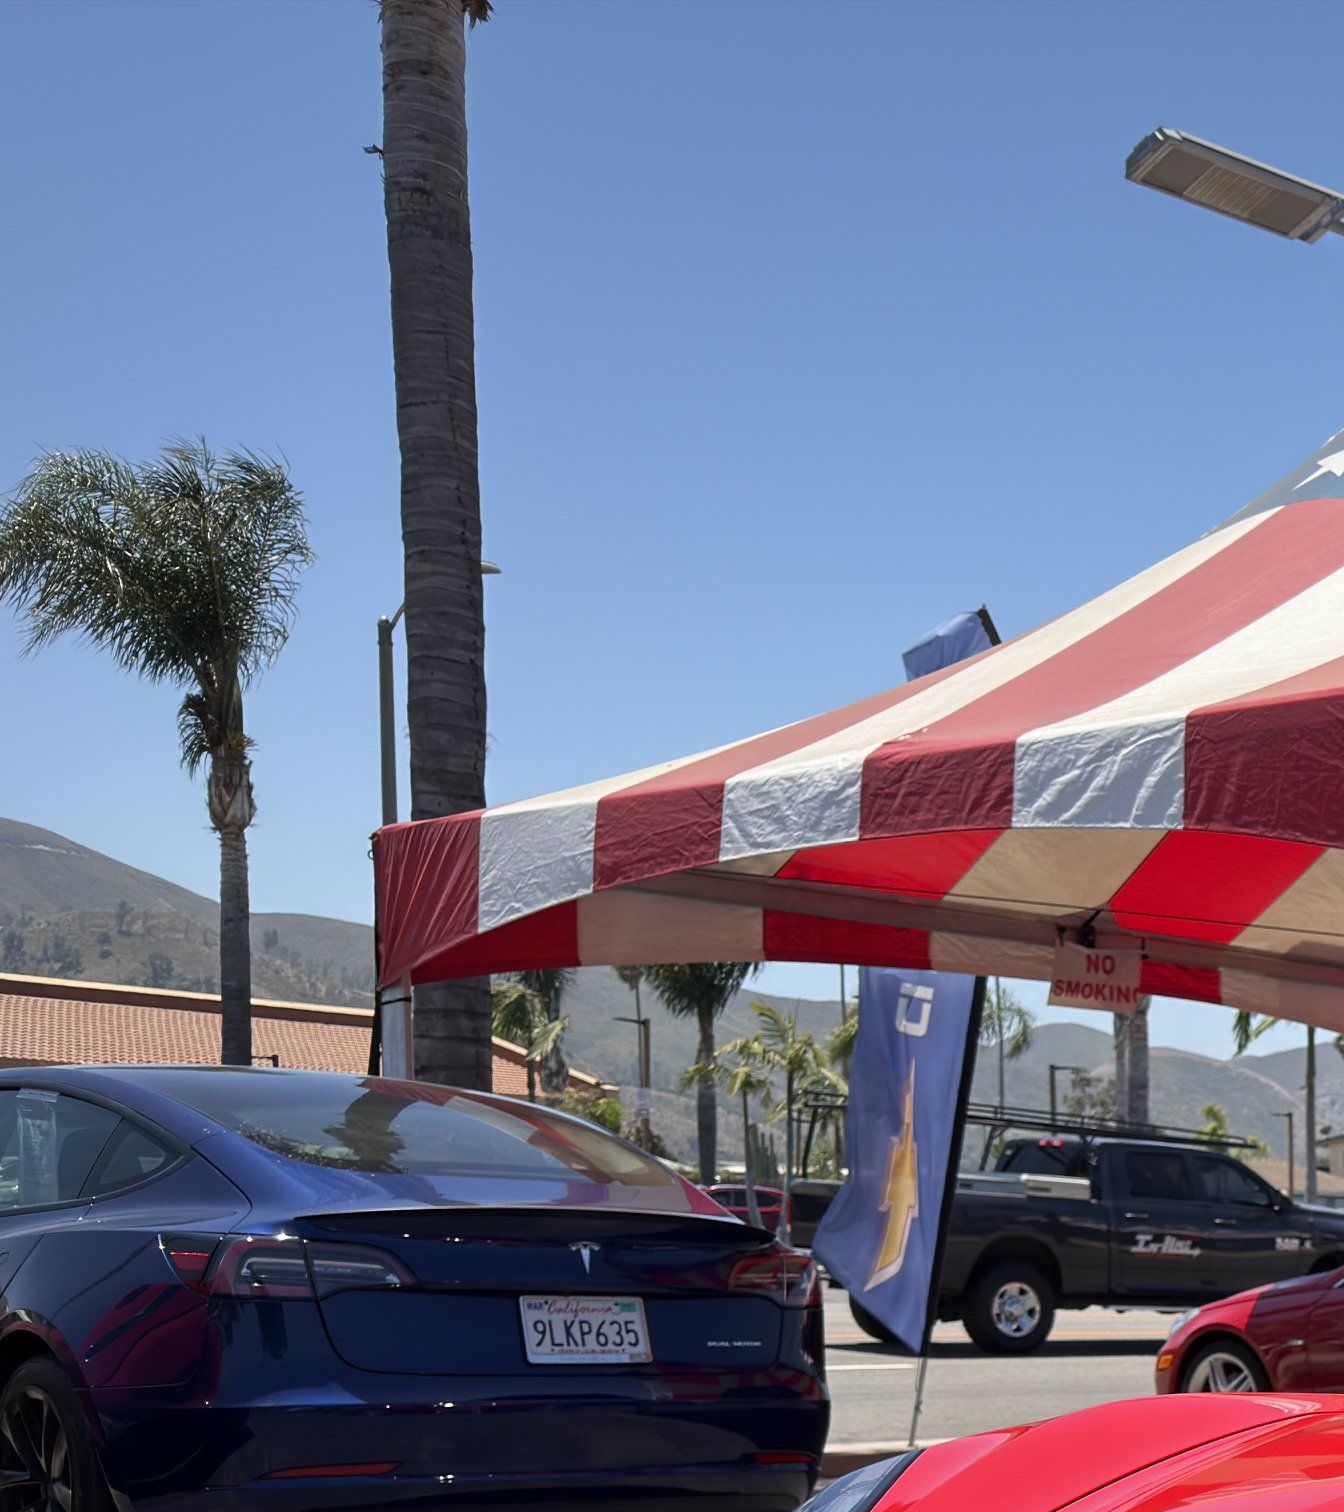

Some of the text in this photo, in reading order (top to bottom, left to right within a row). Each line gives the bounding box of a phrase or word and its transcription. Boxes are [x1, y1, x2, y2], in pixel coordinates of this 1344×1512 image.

[1086, 953, 1116, 975] NO
[547, 1300, 616, 1318] California
[532, 1319, 640, 1348] 9LKP635
